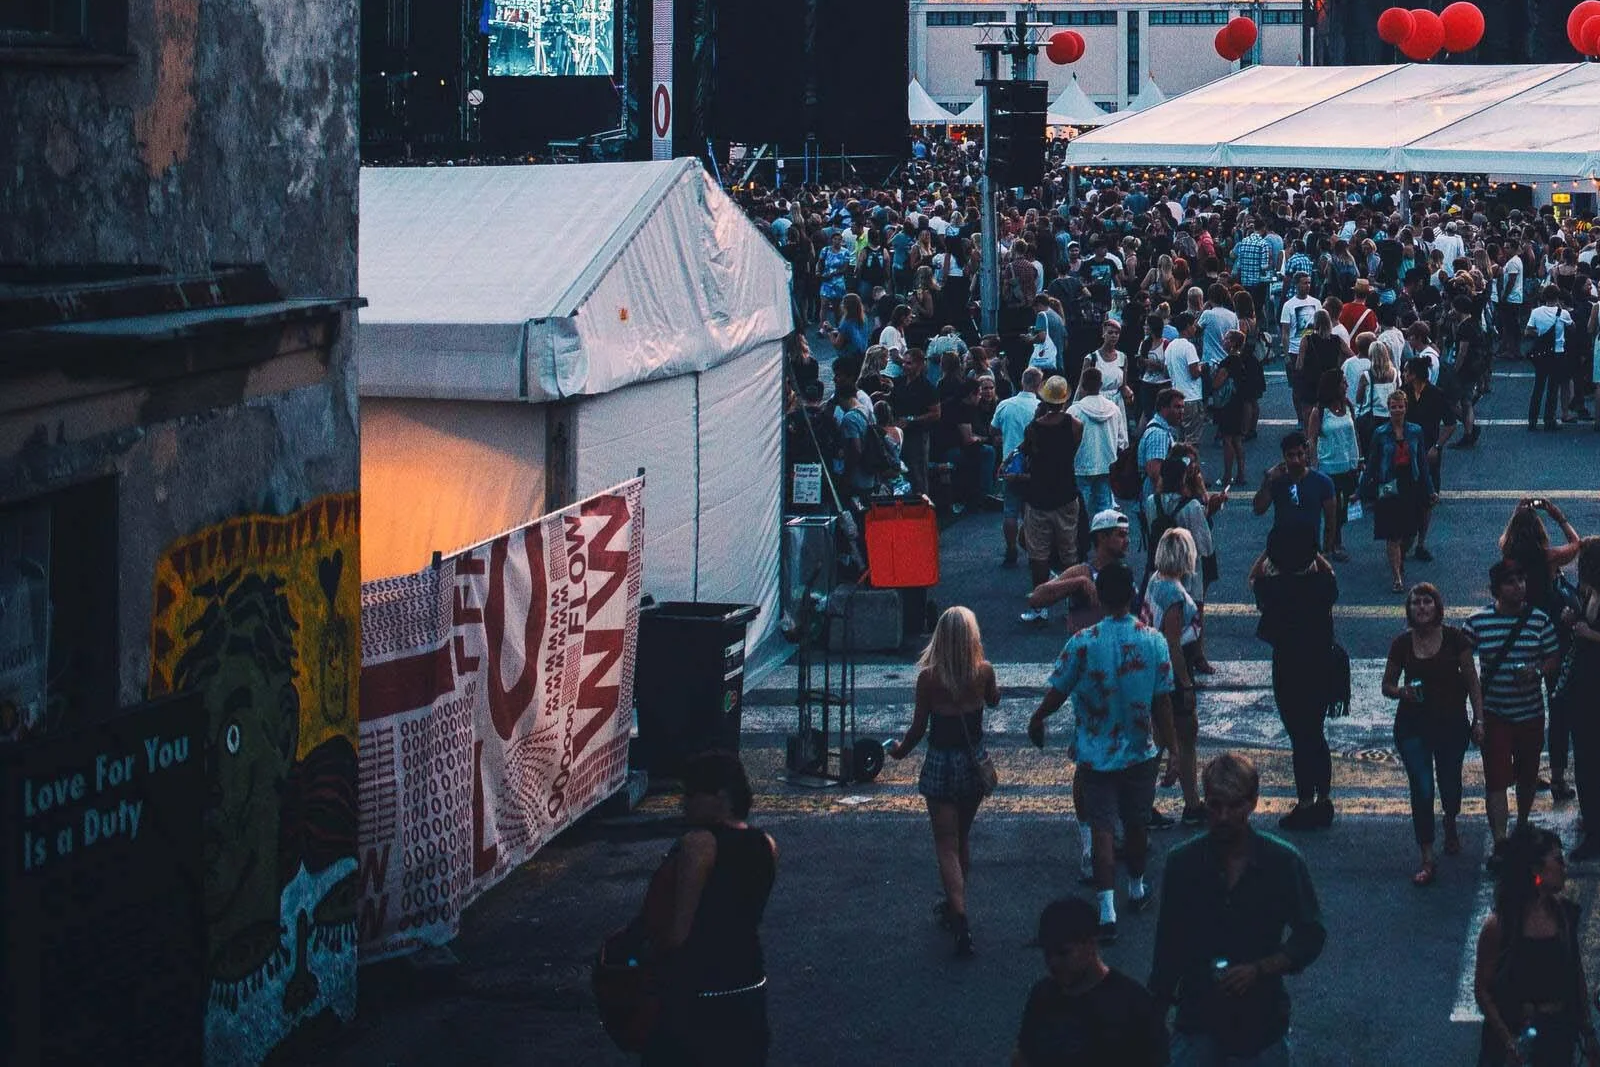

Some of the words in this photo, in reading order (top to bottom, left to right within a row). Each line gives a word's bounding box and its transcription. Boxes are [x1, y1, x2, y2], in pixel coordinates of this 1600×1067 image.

[564, 515, 588, 635] FLOW
[24, 773, 85, 818] Love
[95, 752, 135, 792] For
[144, 735, 190, 774] You
[23, 830, 47, 871] Is
[57, 826, 73, 855] a
[83, 799, 143, 846] Duty
